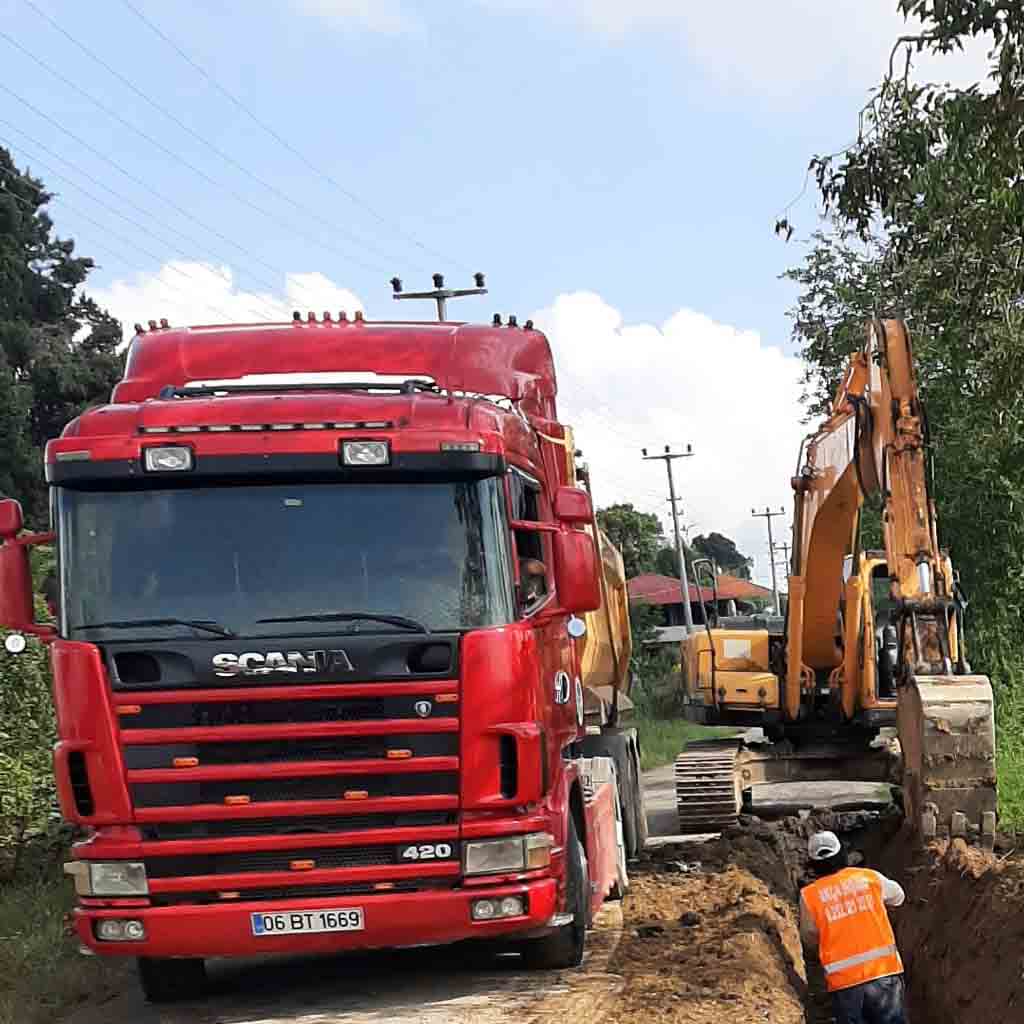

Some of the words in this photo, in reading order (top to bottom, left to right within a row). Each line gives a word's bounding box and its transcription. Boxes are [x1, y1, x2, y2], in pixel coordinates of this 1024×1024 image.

[212, 650, 355, 677] SCANIA
[402, 844, 451, 860] 420
[263, 915, 286, 931] 06
[290, 913, 314, 930] BT
[319, 911, 360, 929] 1669
